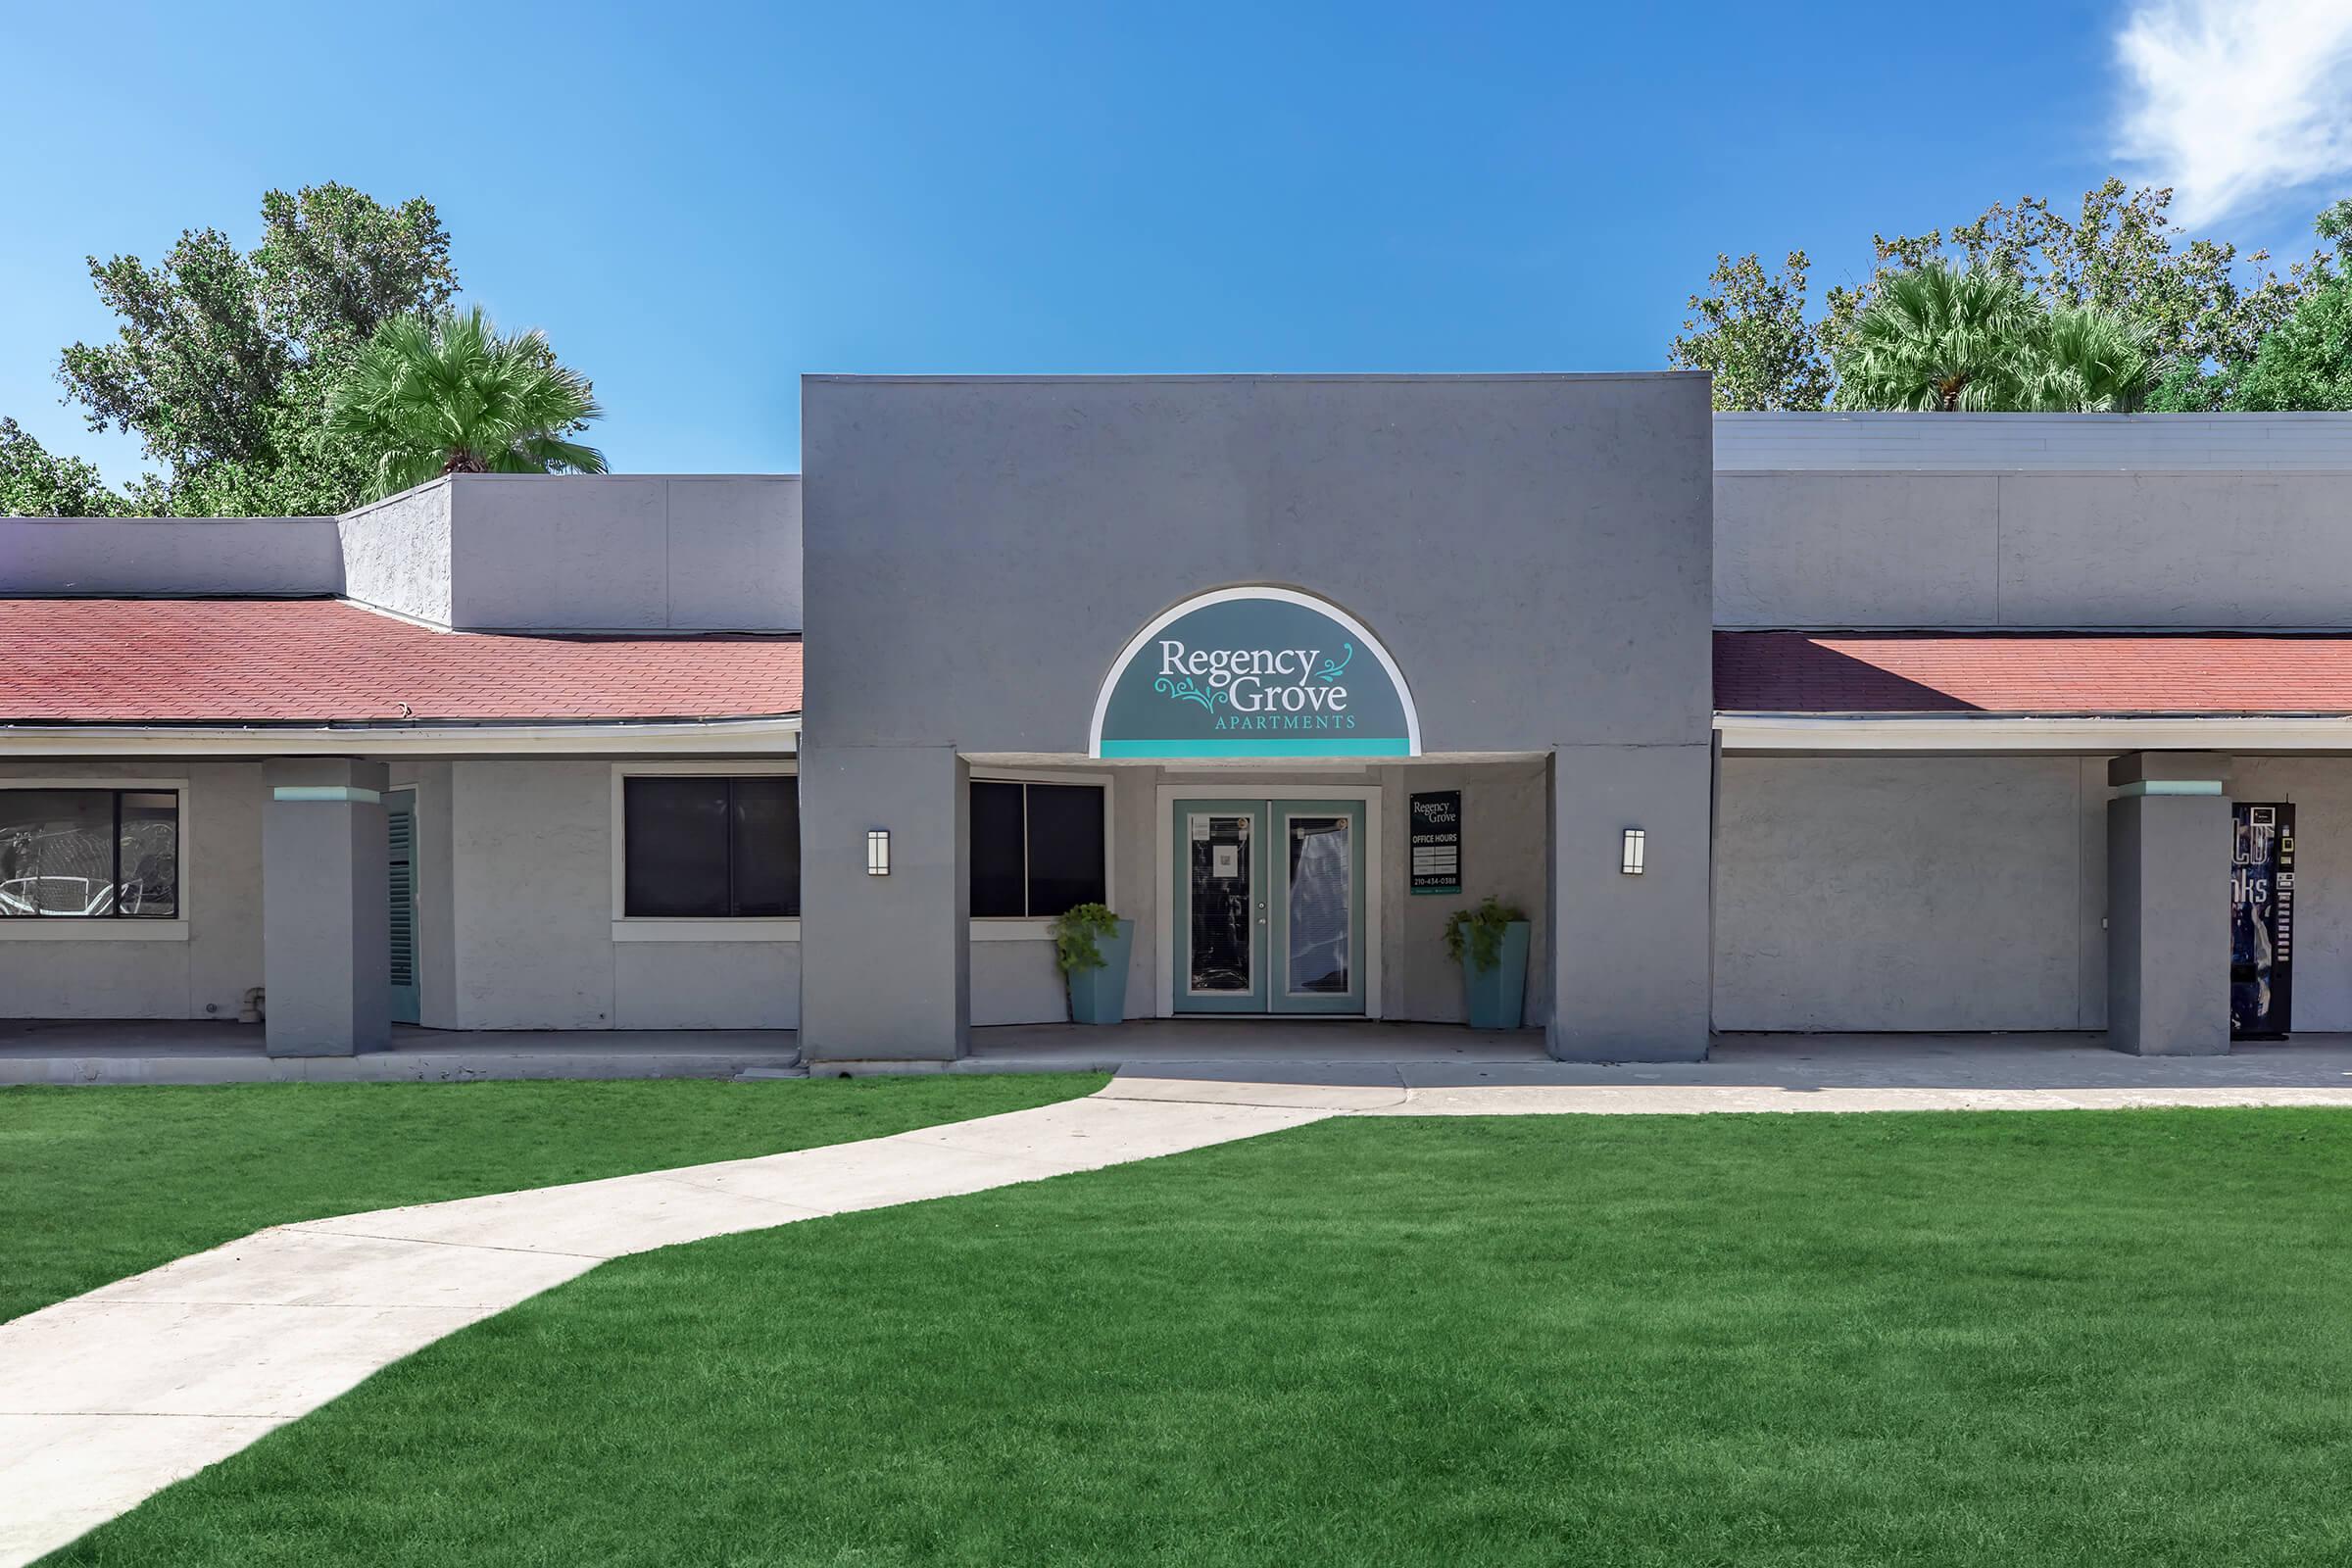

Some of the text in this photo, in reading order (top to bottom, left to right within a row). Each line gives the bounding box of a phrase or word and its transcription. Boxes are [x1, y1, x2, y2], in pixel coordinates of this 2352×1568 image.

[1158, 641, 1320, 687] Regency
[1229, 677, 1348, 711] Grove
[1215, 715, 1355, 730] APARTMENTS
[1414, 802, 1449, 815] Regency
[1429, 811, 1456, 823] Grove
[1412, 834, 1457, 844] OFFICE HOURS
